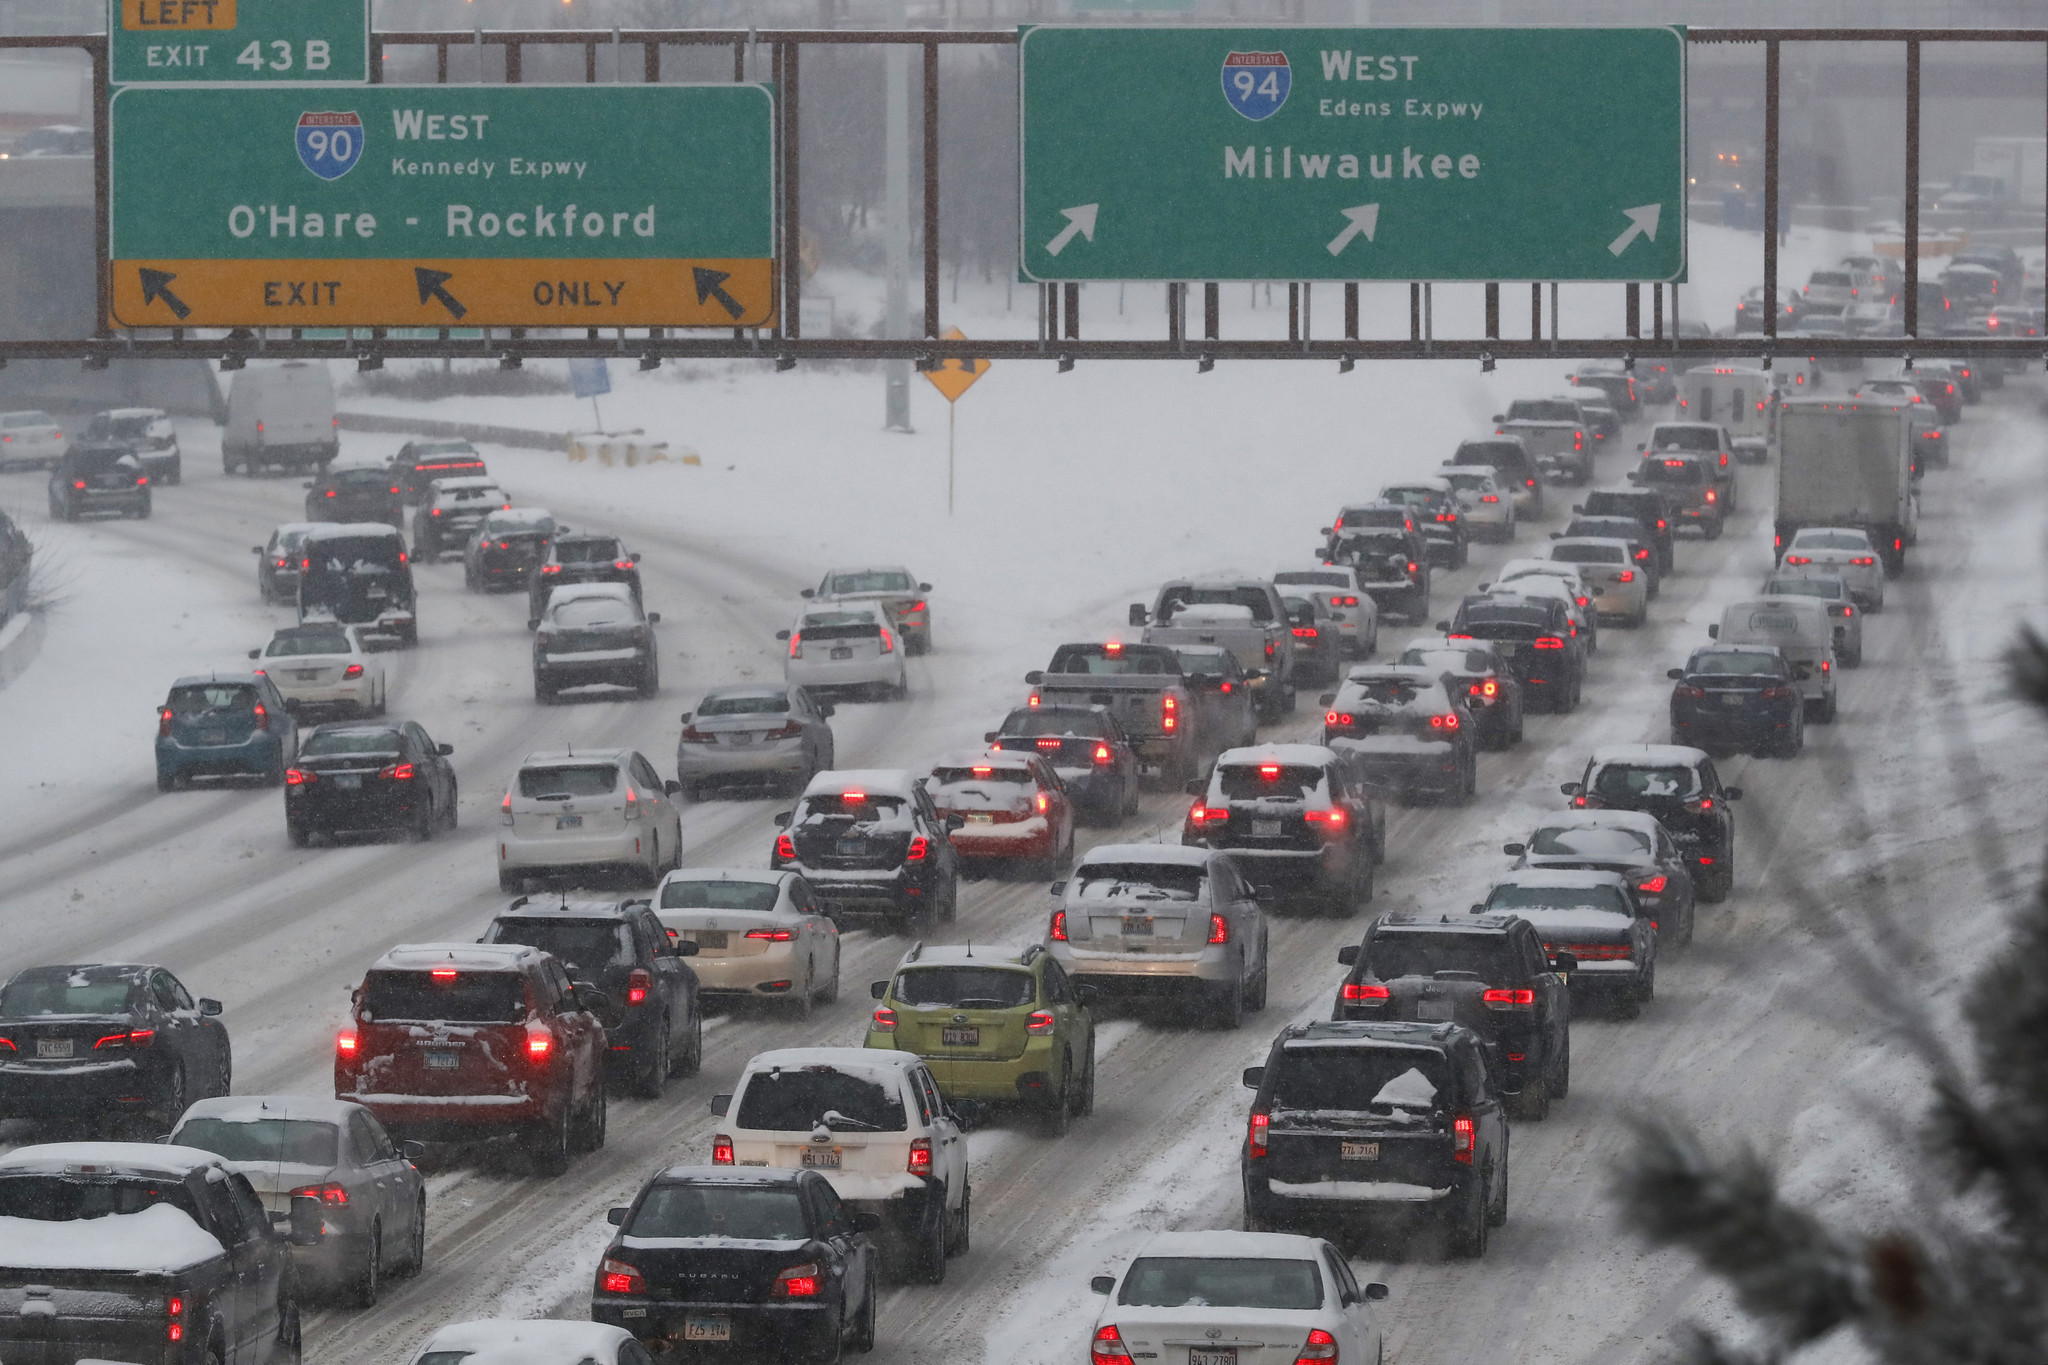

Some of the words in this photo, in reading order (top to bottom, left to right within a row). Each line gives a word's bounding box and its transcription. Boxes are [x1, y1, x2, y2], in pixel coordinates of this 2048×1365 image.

[140, 0, 218, 25] LEFT
[146, 46, 210, 67] EXIT
[1232, 55, 1280, 65] INTERSTATE
[1320, 50, 1419, 81] WEST
[1233, 71, 1280, 102] 94
[1319, 99, 1391, 117] Edens
[1405, 99, 1484, 120] Expwy
[305, 115, 353, 126] INTERSTATE
[392, 109, 489, 140] WEST
[307, 130, 352, 162] 90
[391, 158, 495, 179] Kennedy
[509, 158, 588, 179] Expwy
[1224, 146, 1481, 179] Milwaukee
[228, 204, 378, 238] O'Hare
[446, 204, 656, 238] Rockford
[263, 280, 342, 307] EXIT
[532, 280, 627, 307] ONLY
[1425, 984, 1446, 994] Jeep
[821, 1154, 840, 1166] 1743
[624, 1310, 646, 1318] RVCA
[710, 1324, 726, 1337] 174
